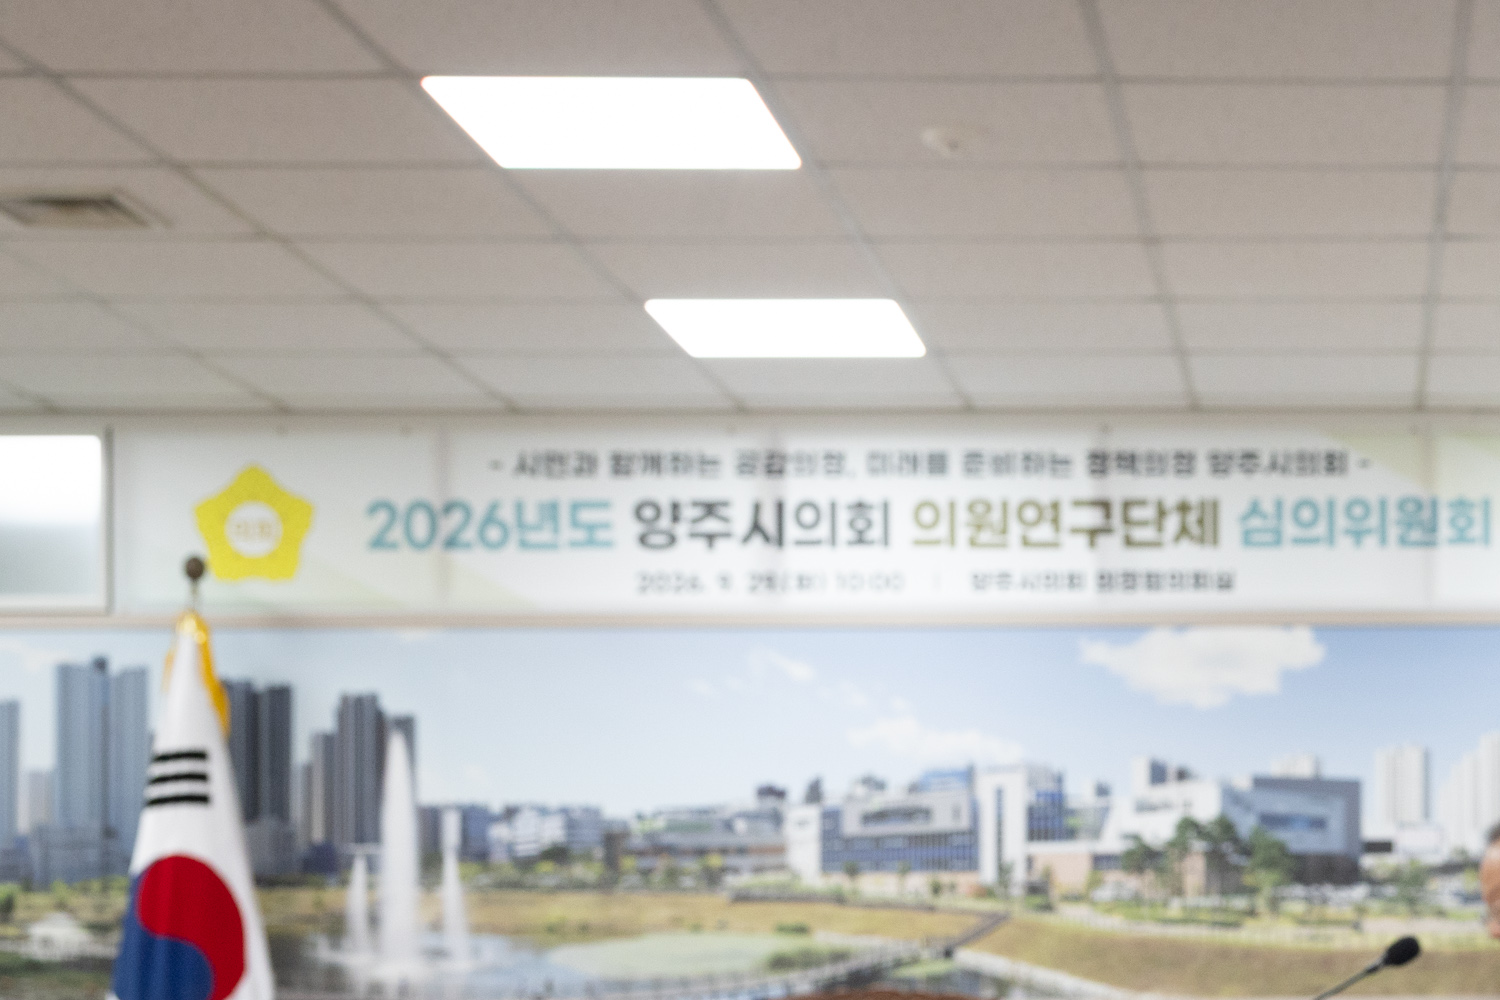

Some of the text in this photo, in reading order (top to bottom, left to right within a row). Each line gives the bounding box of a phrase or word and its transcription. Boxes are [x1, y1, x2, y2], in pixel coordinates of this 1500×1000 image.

[514, 453, 598, 478] 시민과
[610, 453, 719, 478] 함께하는
[867, 453, 947, 477] 미래를
[963, 453, 1071, 477] 준비하는
[1210, 451, 1348, 476] 양주시의회
[366, 497, 1490, 550] 2026년도 양주시의회 의원연구단체 심의위원회
